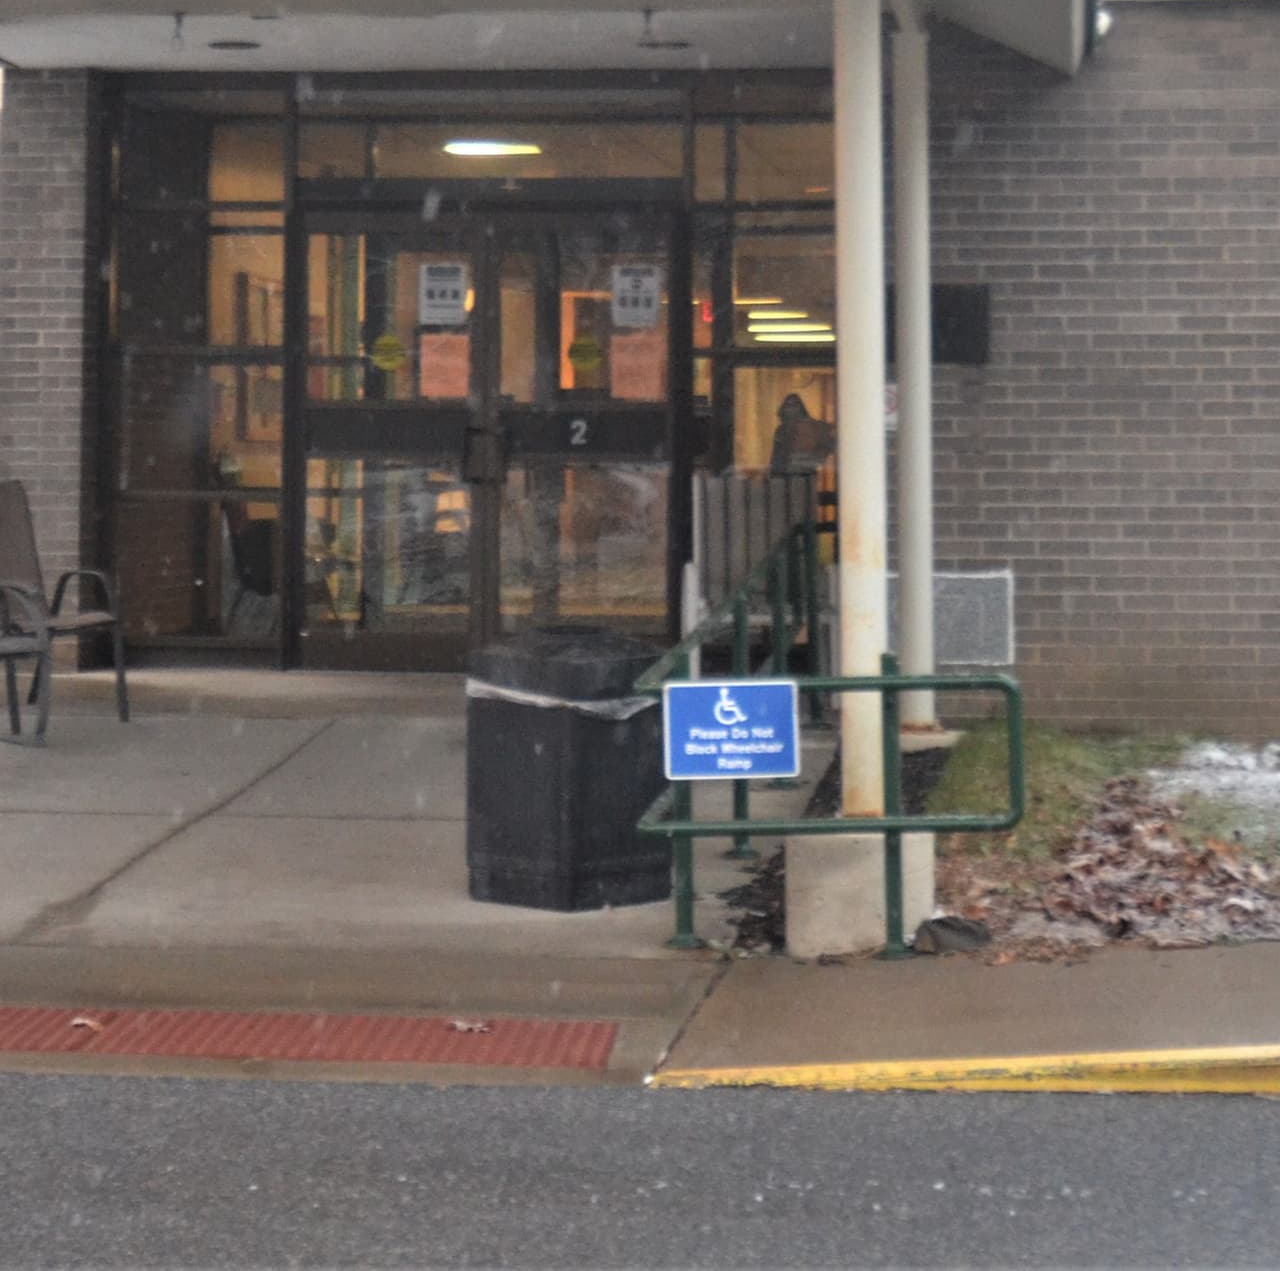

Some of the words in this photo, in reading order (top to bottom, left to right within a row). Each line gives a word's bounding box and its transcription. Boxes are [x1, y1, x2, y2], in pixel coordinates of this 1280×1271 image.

[571, 420, 587, 444] 2
[690, 728, 728, 740] Please
[731, 728, 749, 739] Do
[752, 727, 774, 739] Not
[685, 743, 718, 755] Block
[721, 742, 784, 754] Wheelchair
[718, 758, 753, 770] Ramp
